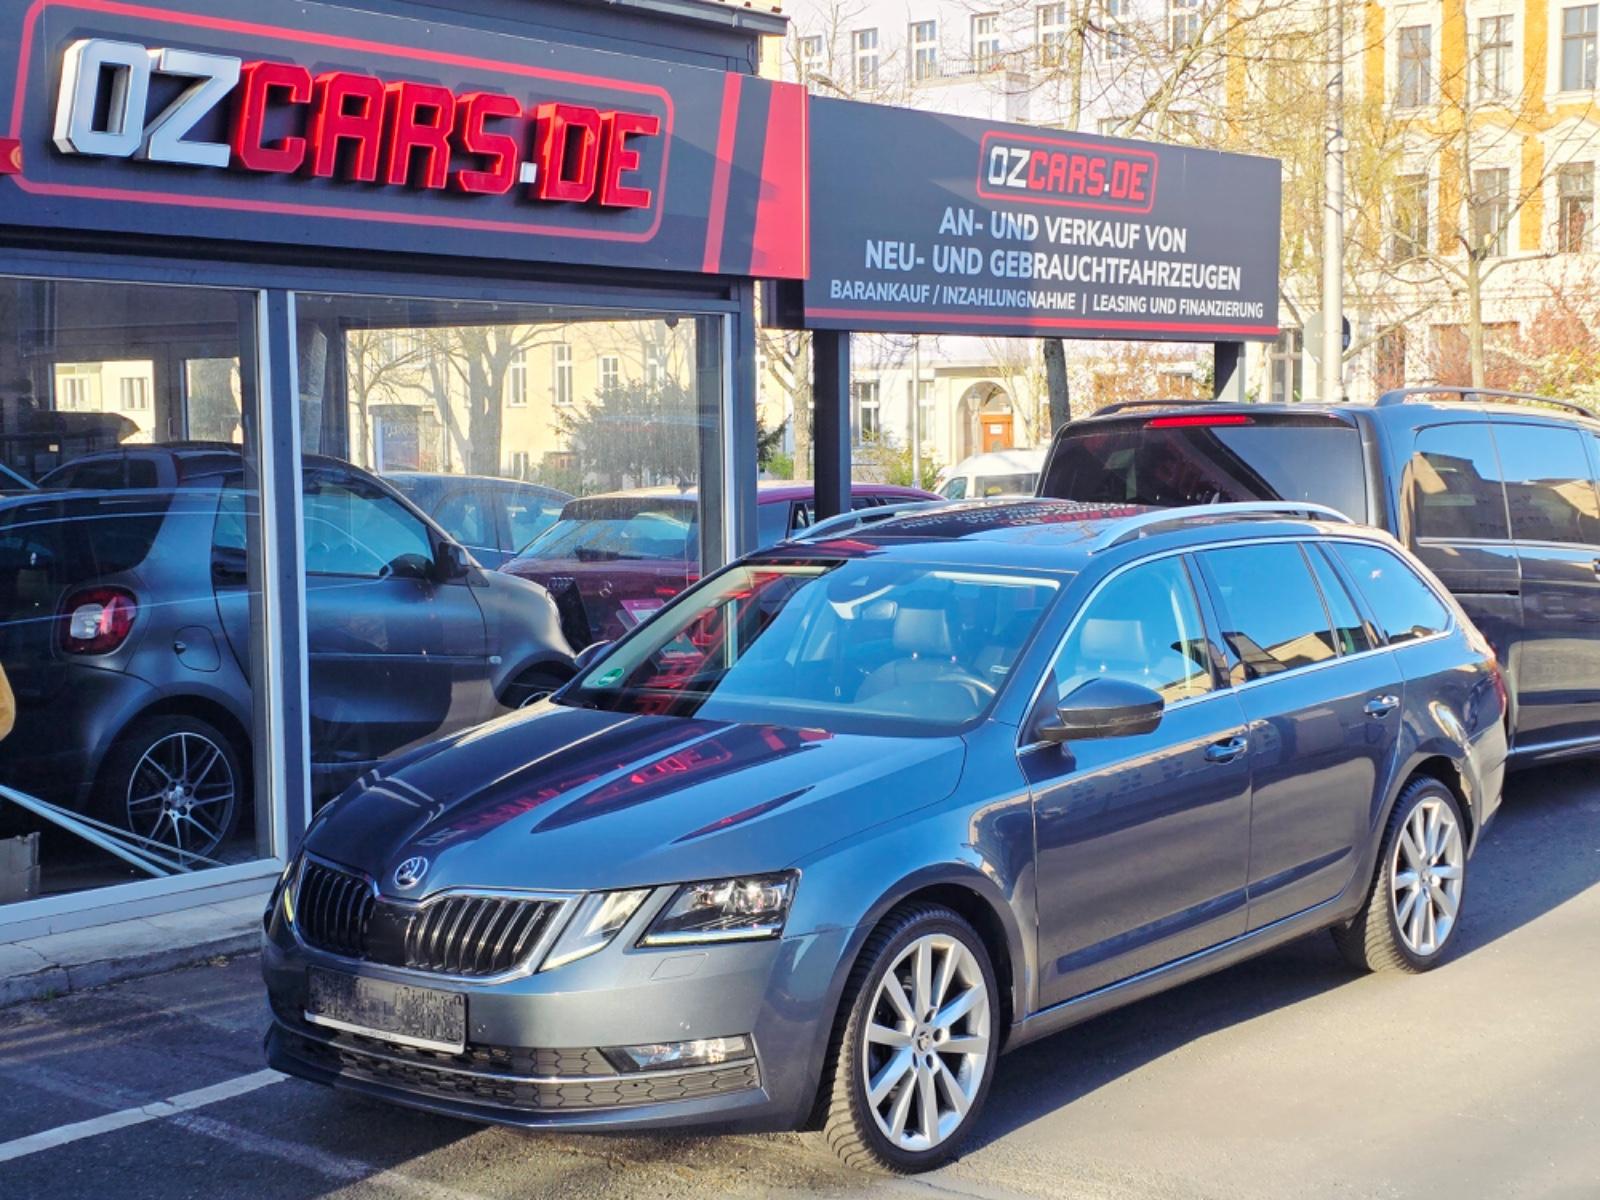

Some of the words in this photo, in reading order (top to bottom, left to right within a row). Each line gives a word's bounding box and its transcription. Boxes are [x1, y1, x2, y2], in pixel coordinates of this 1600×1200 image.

[53, 38, 660, 209] OZCARS.DE
[988, 145, 1148, 201] OZCARS.DE
[938, 206, 984, 237] AN-
[991, 210, 1039, 241] UND
[1045, 215, 1140, 250] VERKAUF
[1145, 224, 1187, 253] VON
[865, 239, 925, 272] NEU-
[932, 244, 983, 275] UND
[990, 249, 1241, 291] GEBRAUCHTFAHRZEUGEN
[830, 279, 930, 302] BARANKAUF
[932, 284, 940, 305] /
[943, 285, 1076, 311] INZAHLUNGNAHME
[1093, 293, 1147, 313] LEASING
[1150, 295, 1177, 314] UND
[1179, 298, 1263, 319] FINANZIERUNG
